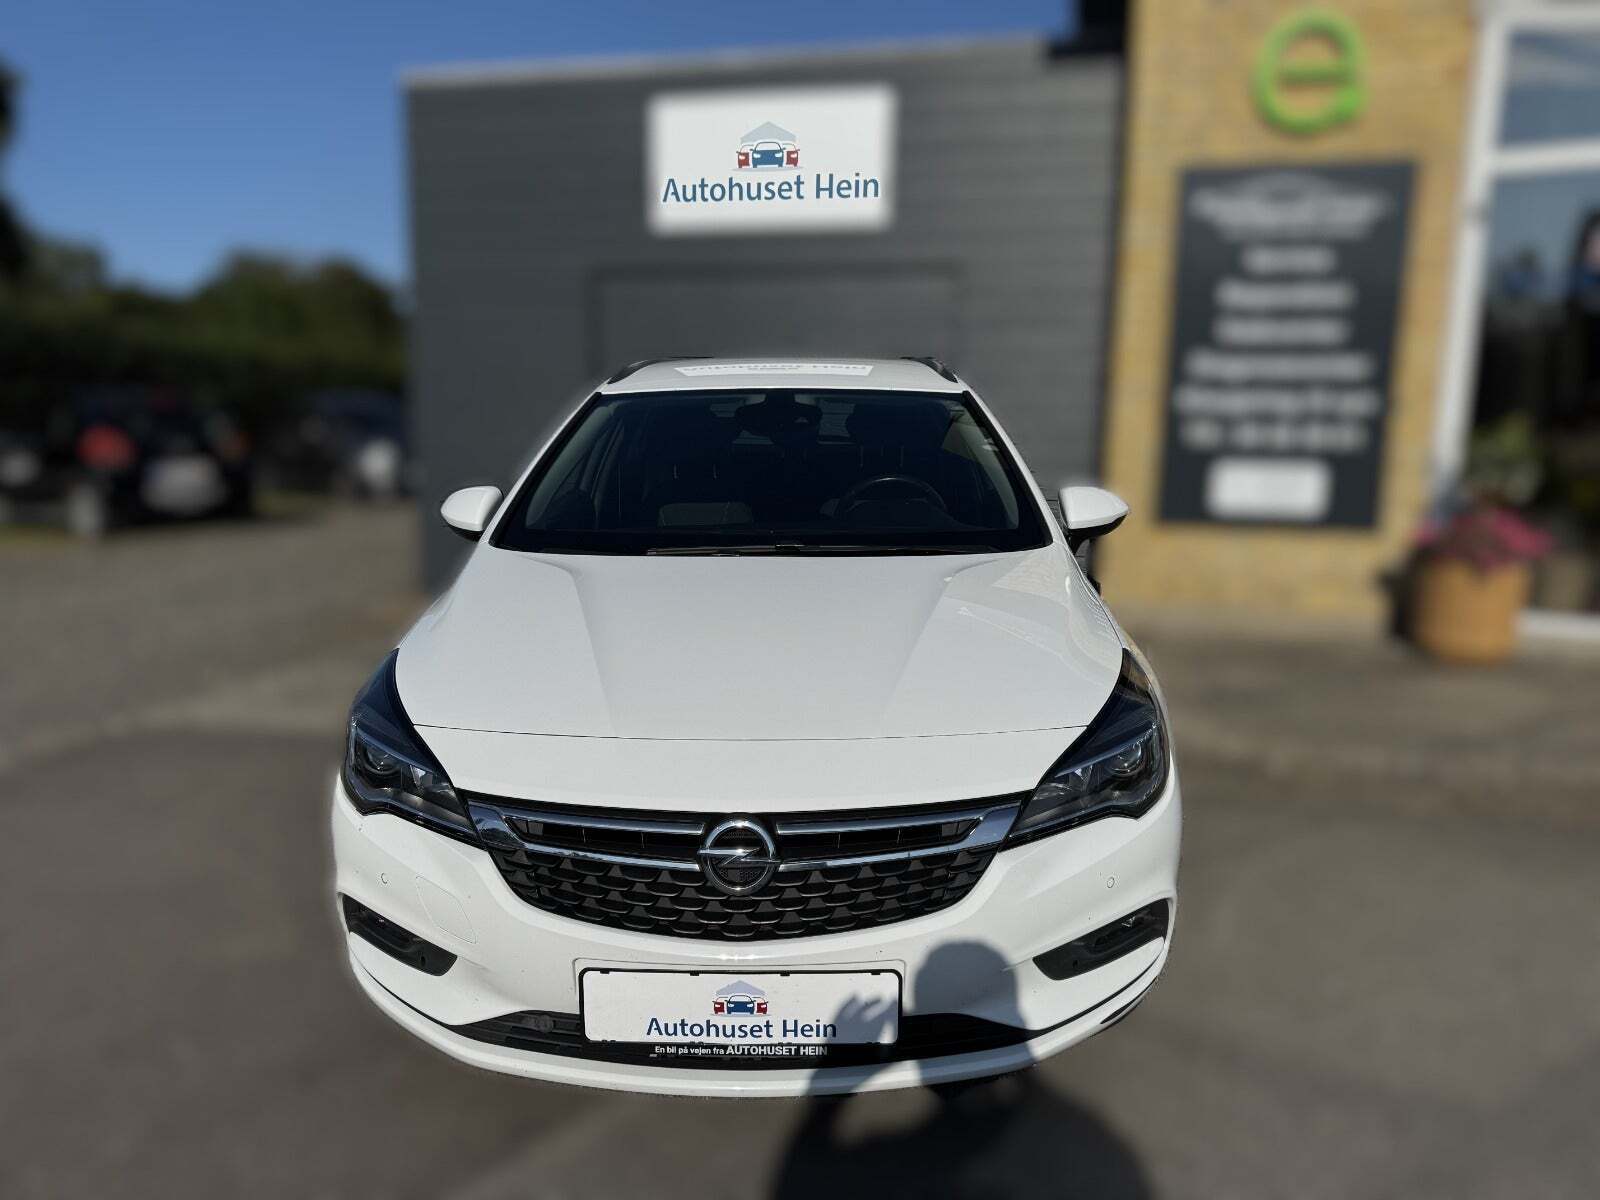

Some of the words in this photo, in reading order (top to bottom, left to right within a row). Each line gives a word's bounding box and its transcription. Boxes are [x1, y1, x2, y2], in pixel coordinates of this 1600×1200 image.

[662, 174, 804, 202] Autohuset
[815, 172, 879, 199] Hein
[646, 1017, 774, 1038] Autohuset
[783, 1019, 837, 1038] Hein
[654, 1045, 666, 1054] En
[666, 1045, 677, 1054] bil
[677, 1045, 689, 1056] på
[712, 1045, 725, 1055] fra
[726, 1045, 798, 1056] AUTOHUSET
[799, 1045, 828, 1056] HEIN
